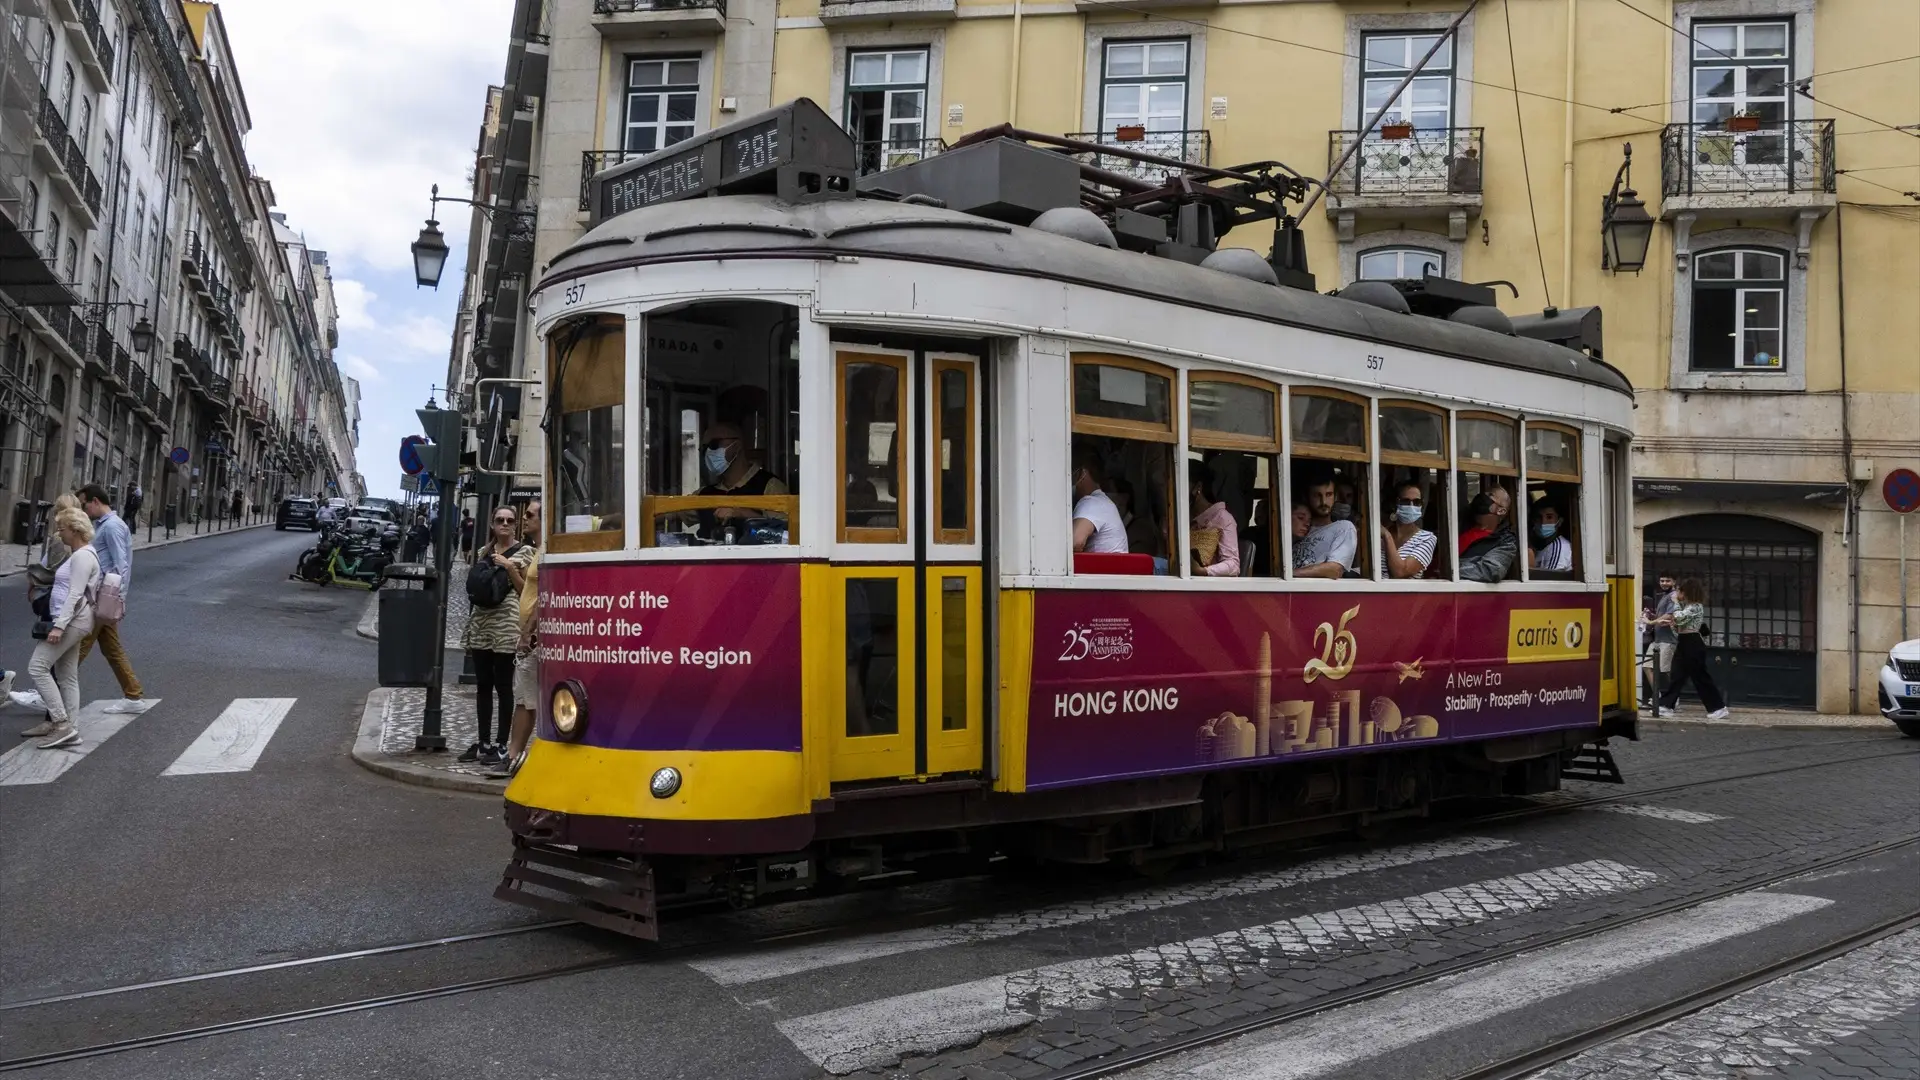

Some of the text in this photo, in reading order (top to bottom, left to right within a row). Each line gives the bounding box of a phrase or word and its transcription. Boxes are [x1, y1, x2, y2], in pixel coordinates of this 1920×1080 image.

[737, 129, 781, 173] 28E
[565, 284, 586, 305] 557
[1366, 354, 1384, 370] 557
[550, 591, 615, 612] Anniversary
[619, 591, 635, 609] of
[639, 591, 669, 609] the
[597, 618, 613, 636] of
[616, 618, 643, 636] the
[1516, 620, 1558, 647] carris
[567, 645, 674, 665] Administrative
[679, 646, 751, 669] Region
[1058, 629, 1092, 661] 25
[1445, 669, 1502, 689] A New Era
[1054, 687, 1179, 717] HONG KONG
[1445, 685, 1588, 712] Stability Prosperity Opportunity
